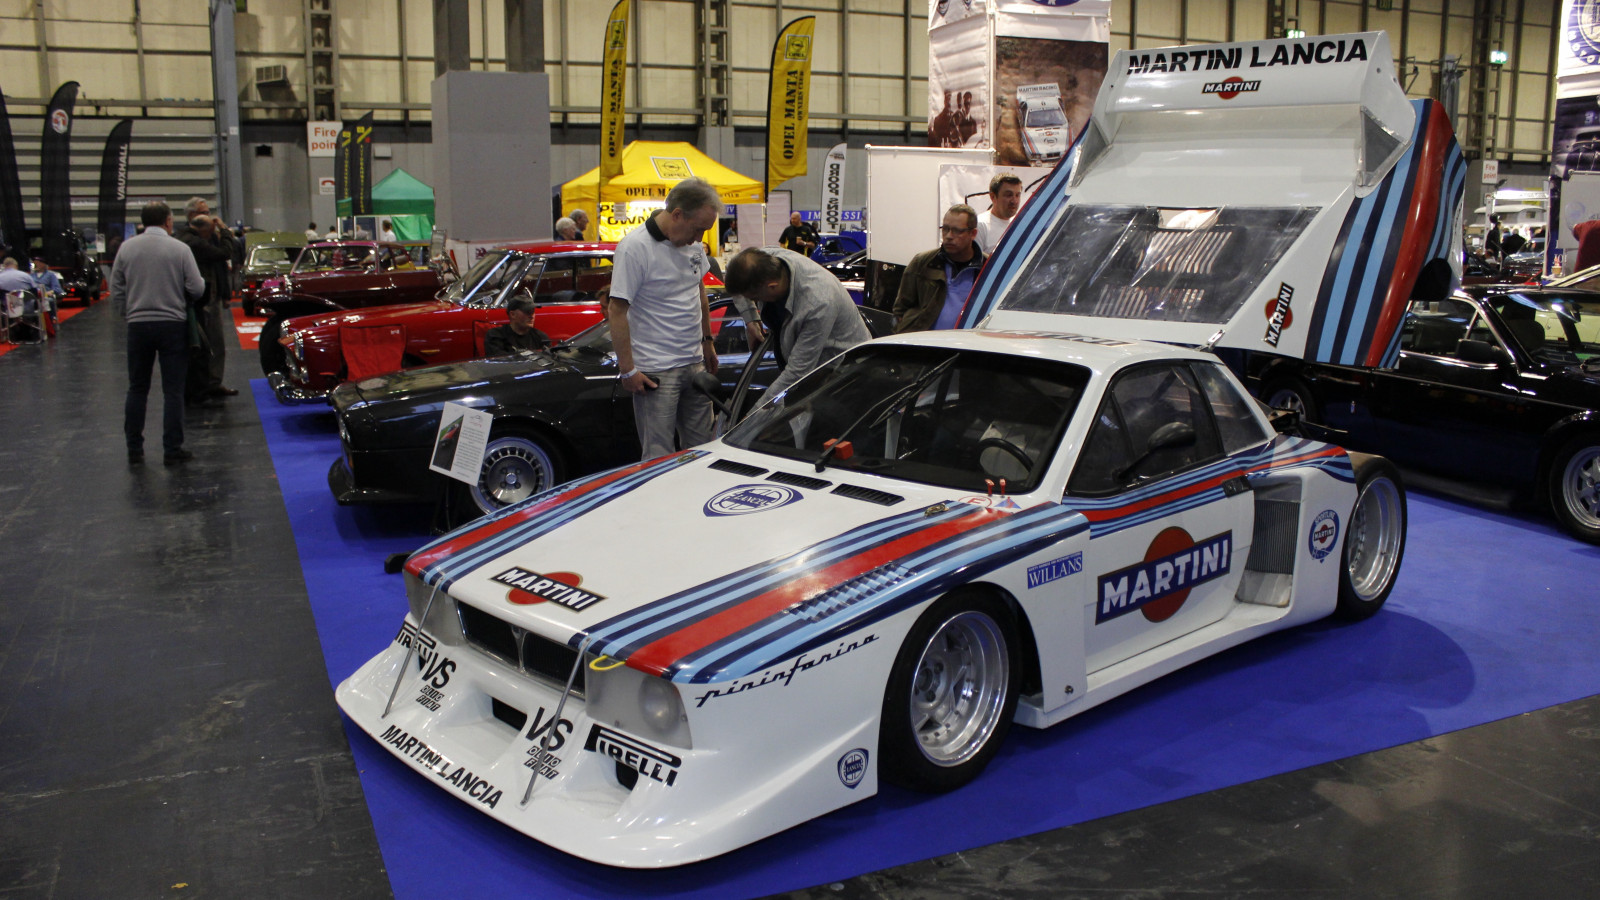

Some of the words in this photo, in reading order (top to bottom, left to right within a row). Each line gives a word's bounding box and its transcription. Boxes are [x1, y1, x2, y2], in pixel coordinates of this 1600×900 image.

[1127, 48, 1243, 75] MARTINI
[1250, 39, 1367, 68] LANCIA
[610, 59, 618, 113] MANTA
[784, 69, 799, 119] MANTA
[1204, 81, 1260, 93] MARTINI
[311, 141, 338, 152] poin
[314, 127, 337, 137] Fire
[608, 117, 616, 157] OPEL
[783, 123, 795, 160] OPEL
[117, 144, 128, 200] VAUXHALL
[625, 187, 653, 196] OPEL
[1267, 285, 1292, 344] MARTINI
[497, 569, 598, 609] MARTINI
[1029, 556, 1081, 586] WILLANS
[1102, 539, 1228, 614] MARTINI
[422, 652, 456, 689] VS
[695, 633, 880, 708] pininfarina
[525, 706, 574, 752] VS
[379, 724, 443, 770] MARTINI
[436, 762, 503, 809] LANCIA
[584, 723, 682, 787] PIRELLI
